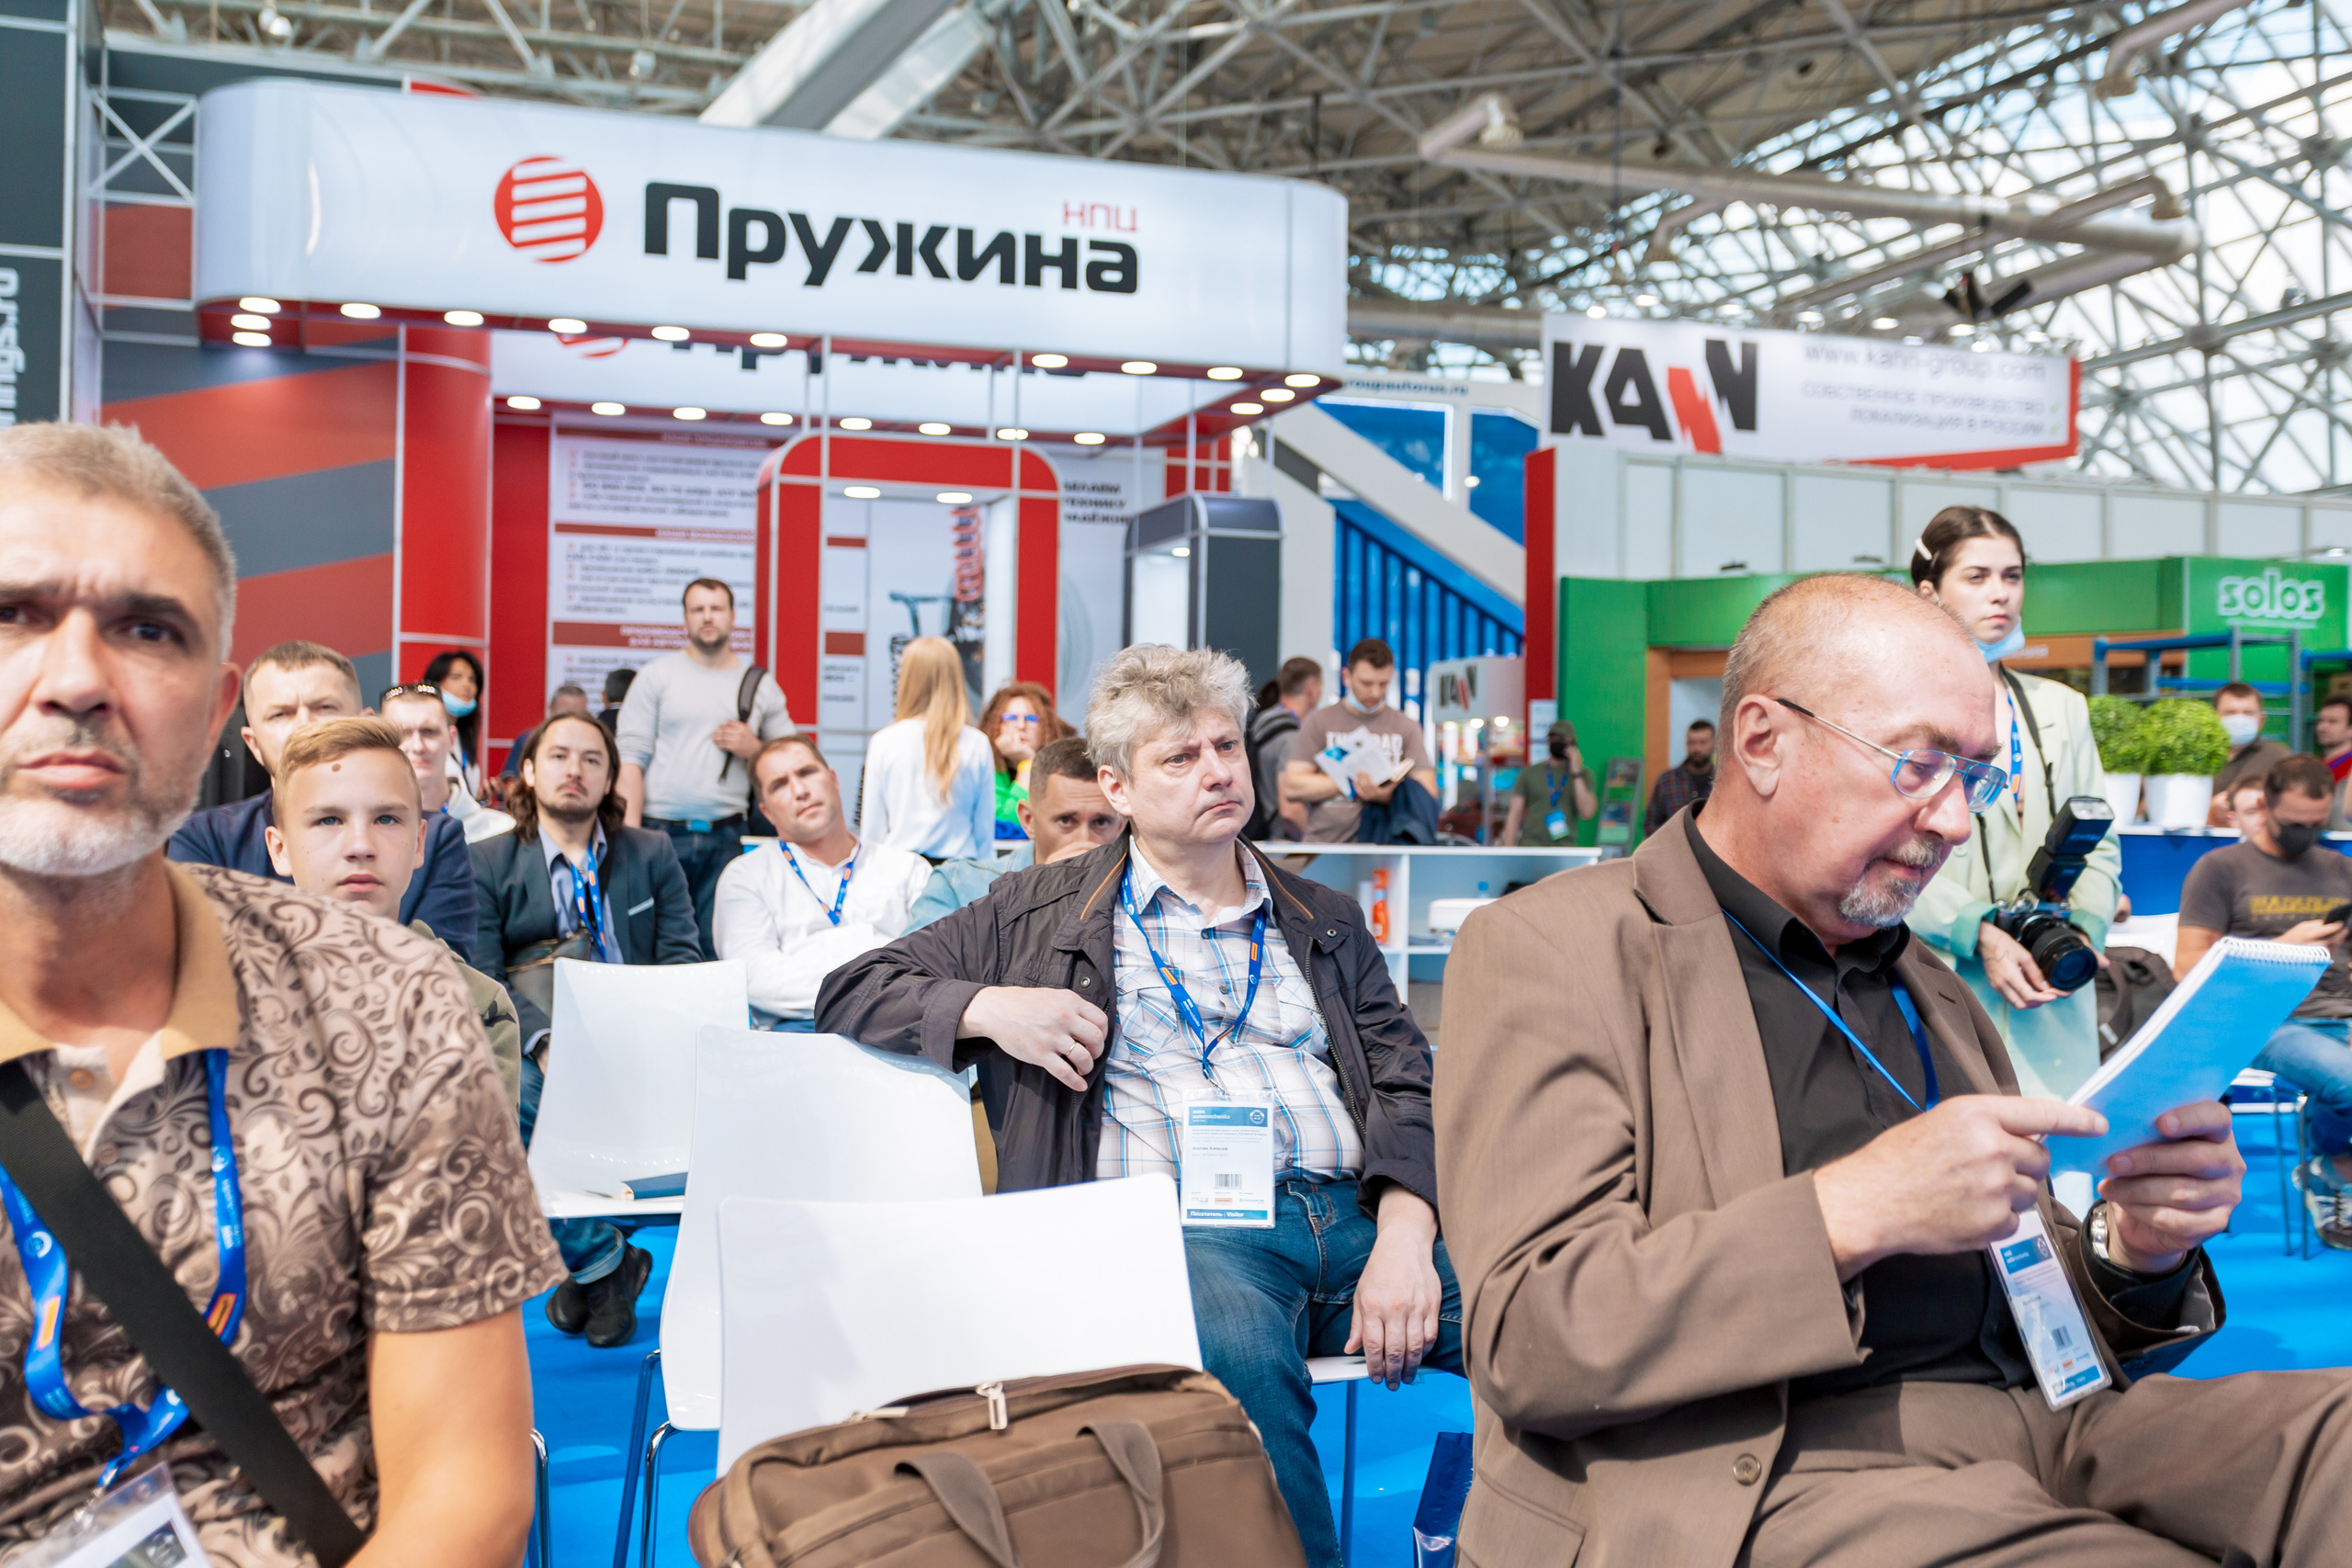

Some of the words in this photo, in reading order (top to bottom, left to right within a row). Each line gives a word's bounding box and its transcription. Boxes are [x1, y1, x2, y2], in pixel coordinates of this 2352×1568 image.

[644, 181, 1138, 294] Пружина
[1062, 201, 1139, 231] НПЦ
[1804, 342, 2046, 380] www.kann-group.com
[1550, 338, 1758, 456] KANN
[2218, 567, 2325, 620] solos
